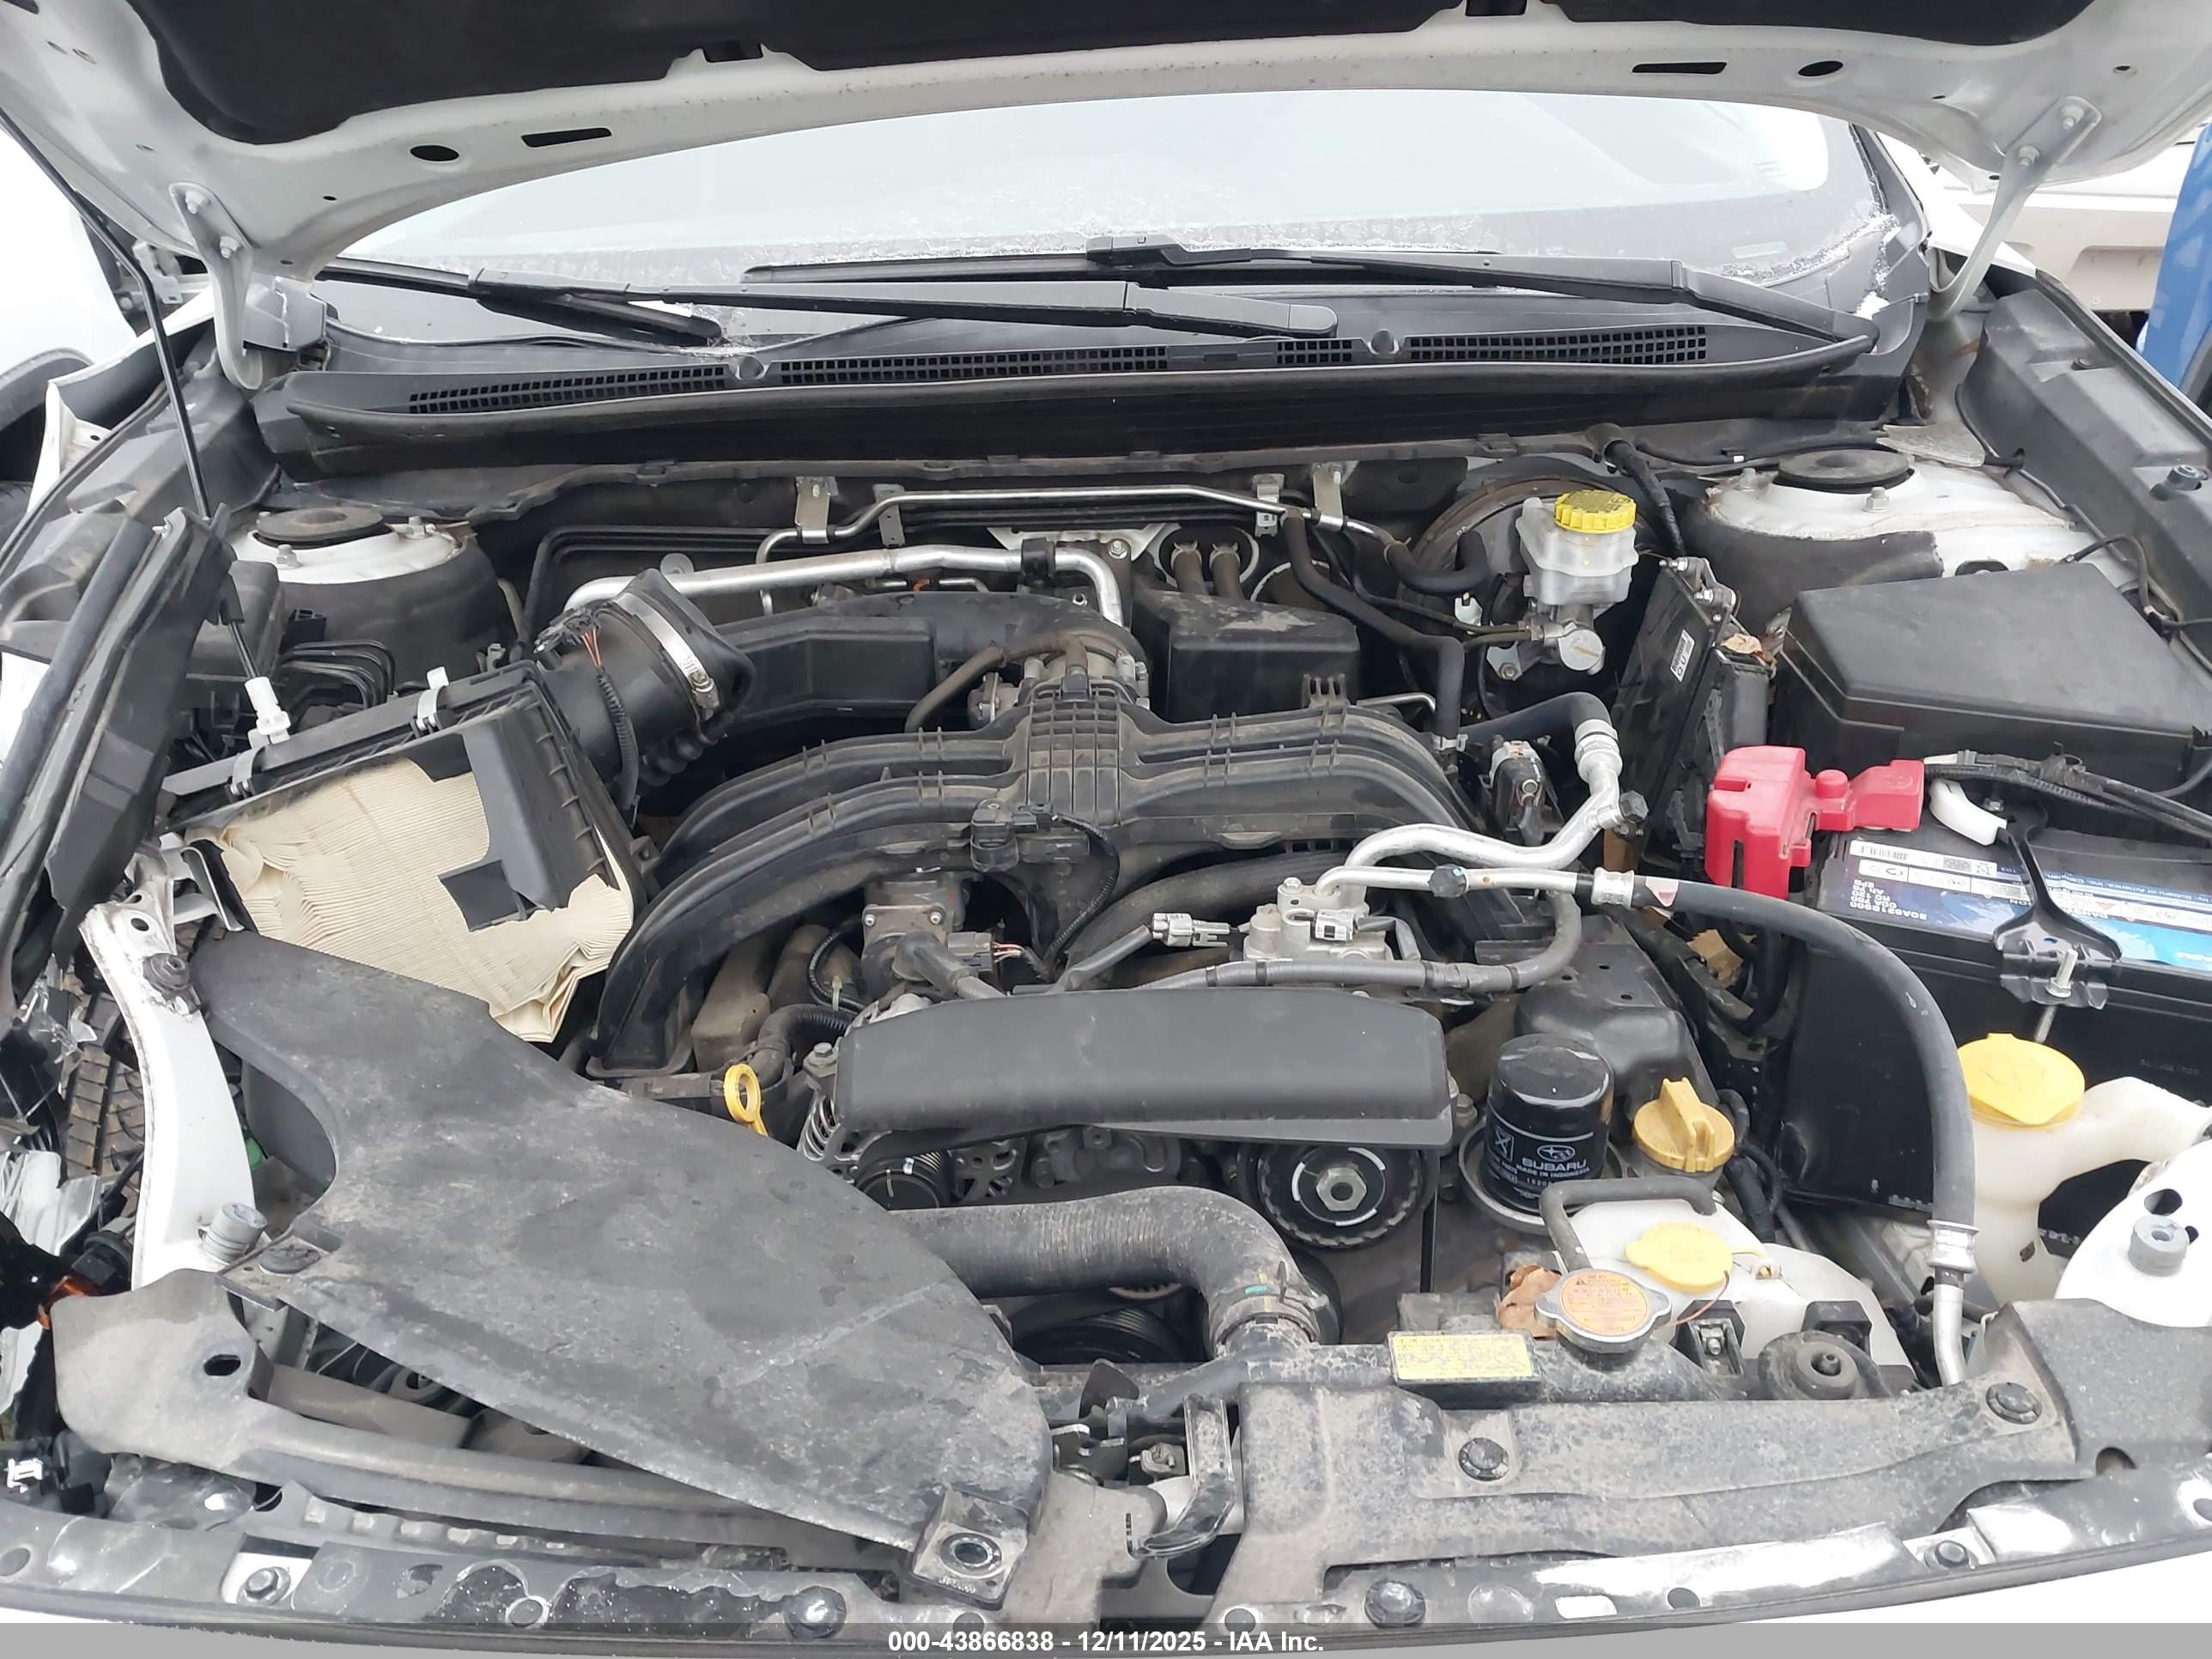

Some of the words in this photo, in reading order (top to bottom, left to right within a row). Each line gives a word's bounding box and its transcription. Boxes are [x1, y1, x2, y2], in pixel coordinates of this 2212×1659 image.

[2159, 890, 2192, 901] Subaru
[1874, 899, 1897, 908] CCA
[1516, 1164, 1538, 1176] MADE
[1540, 1169, 1548, 1177] IN
[1550, 1166, 1590, 1177] INDONESIA
[1522, 1158, 1587, 1171] SUBARU
